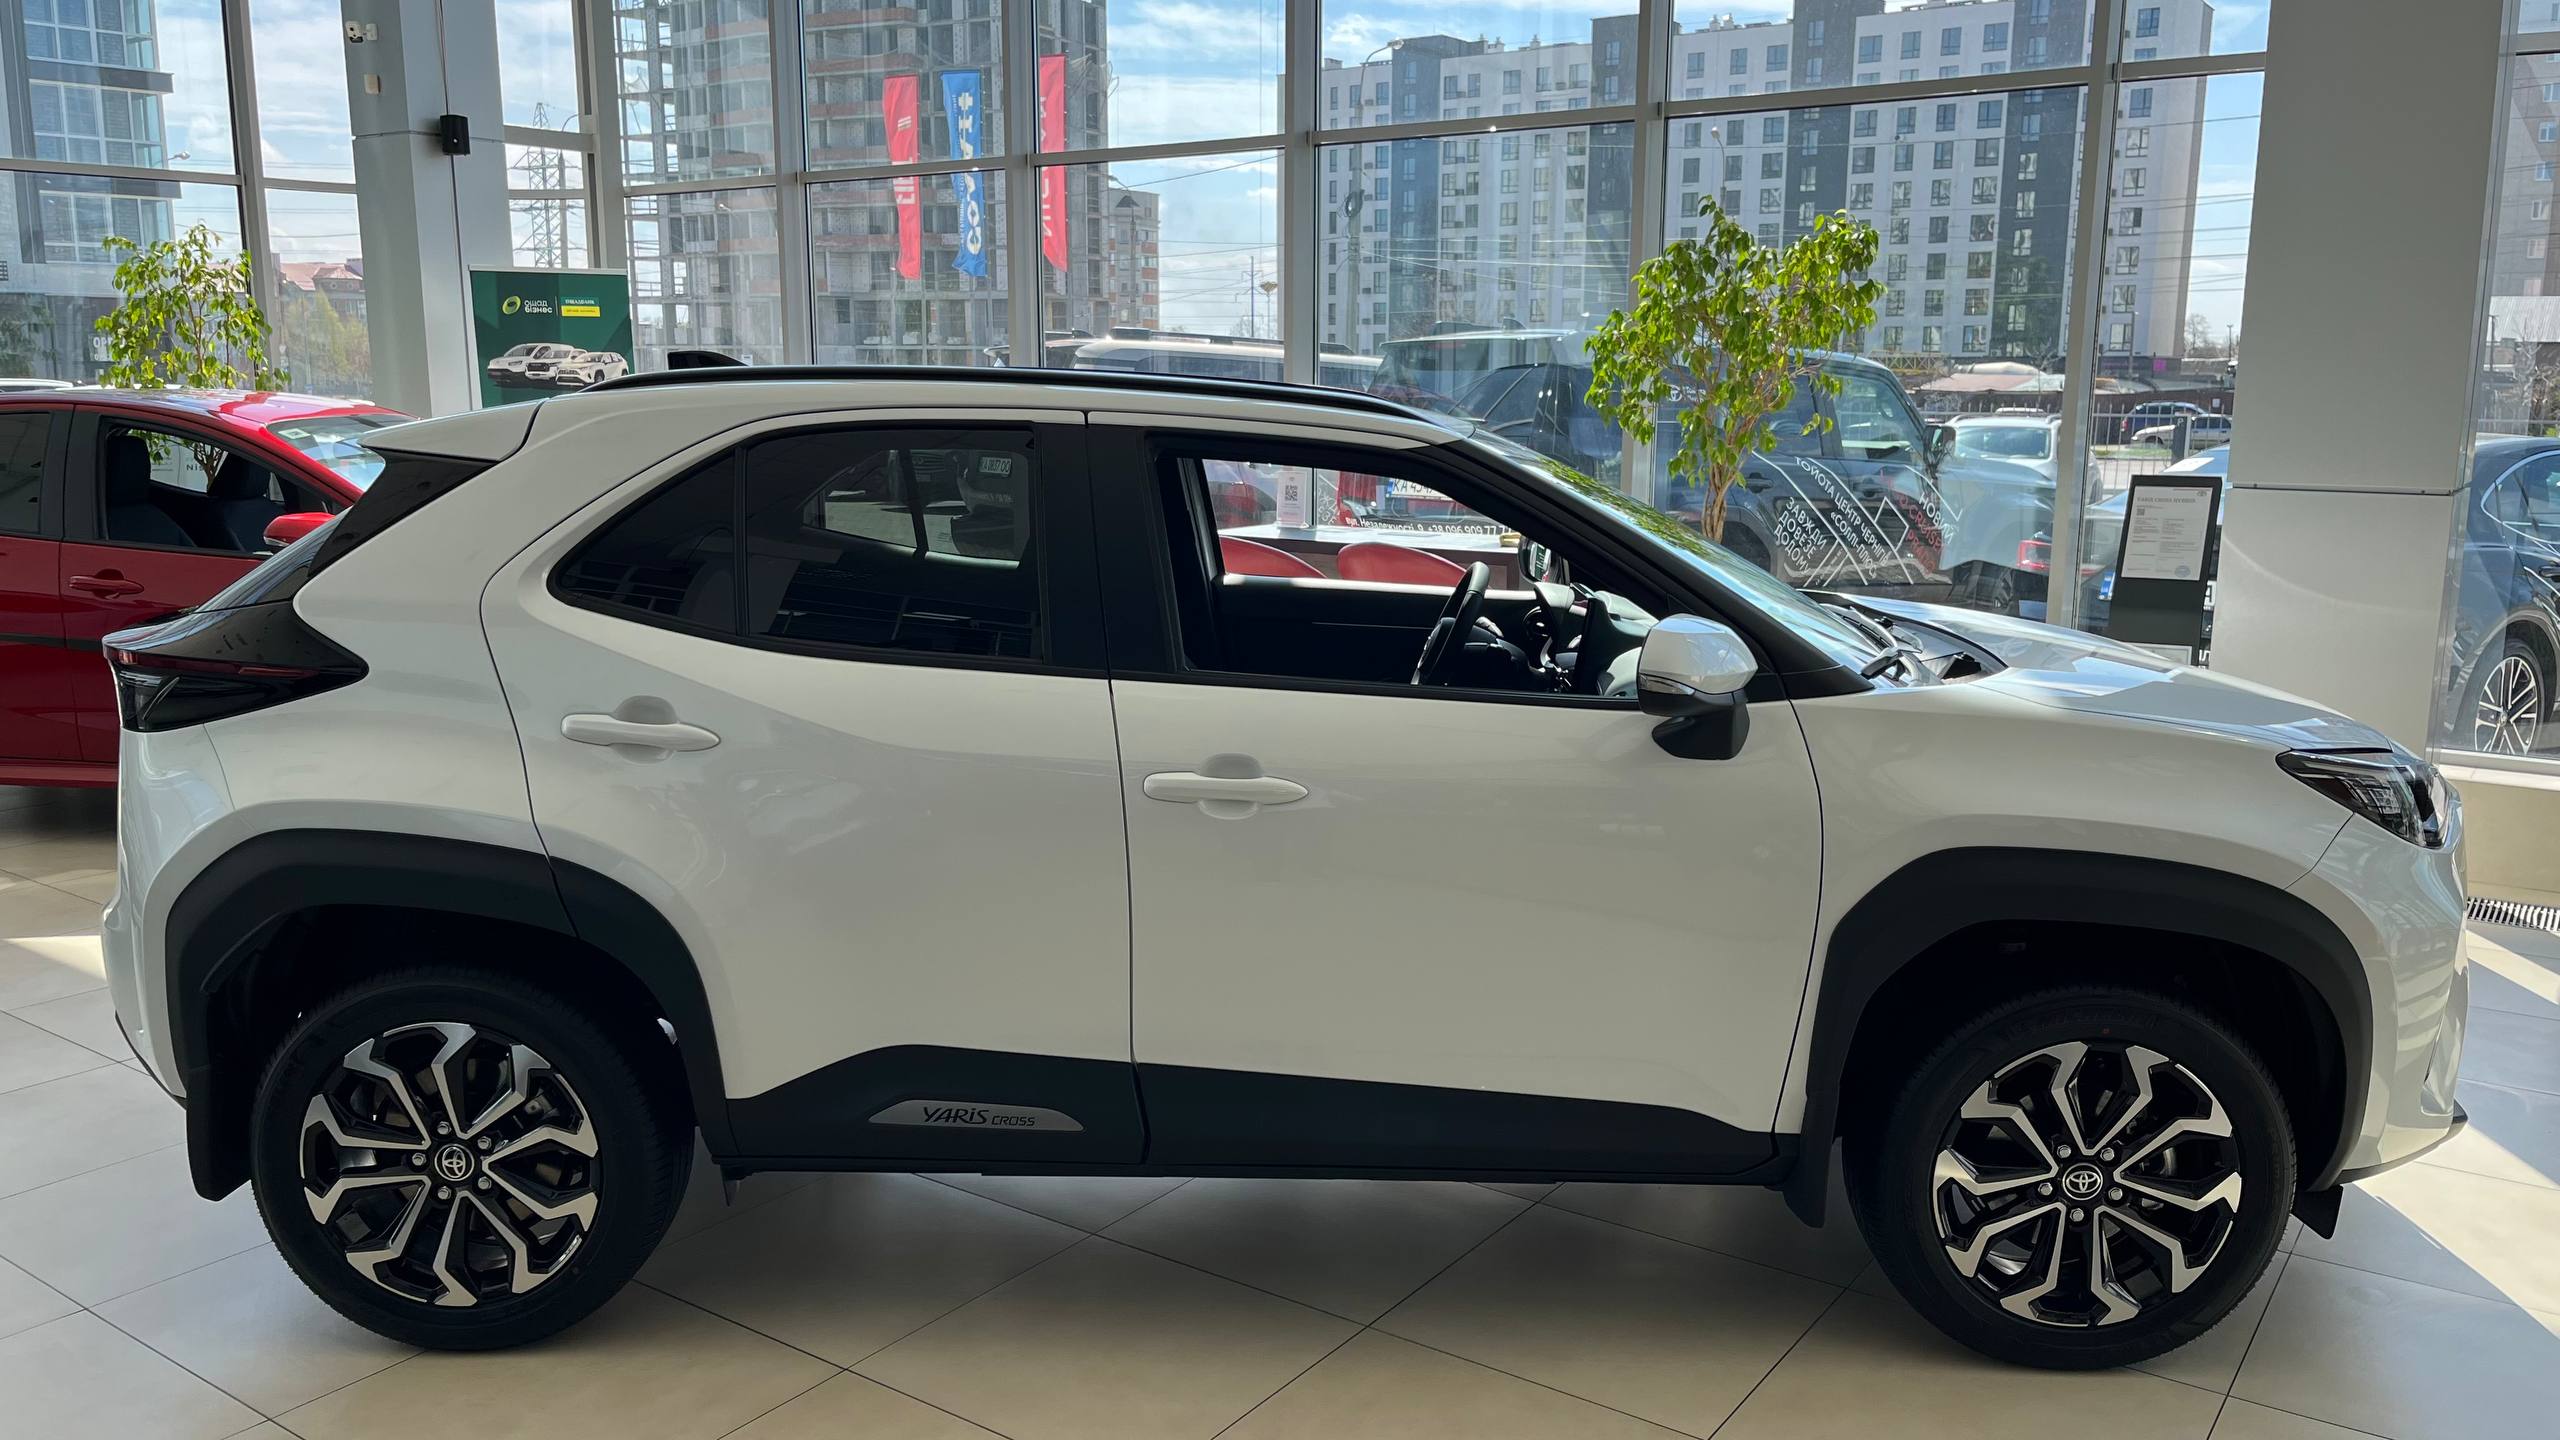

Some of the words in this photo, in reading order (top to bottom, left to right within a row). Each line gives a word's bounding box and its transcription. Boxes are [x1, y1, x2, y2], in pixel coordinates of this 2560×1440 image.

[1795, 456, 1835, 498] ТОЙОТА
[1834, 492, 1862, 526] ЦЕНТР
[1778, 511, 1817, 560] ДОВЕЗЕ
[1786, 497, 1827, 550] ЗАВЖДИ
[1774, 524, 1811, 574] ДОДОМУ
[991, 1115, 1035, 1127] CROSS
